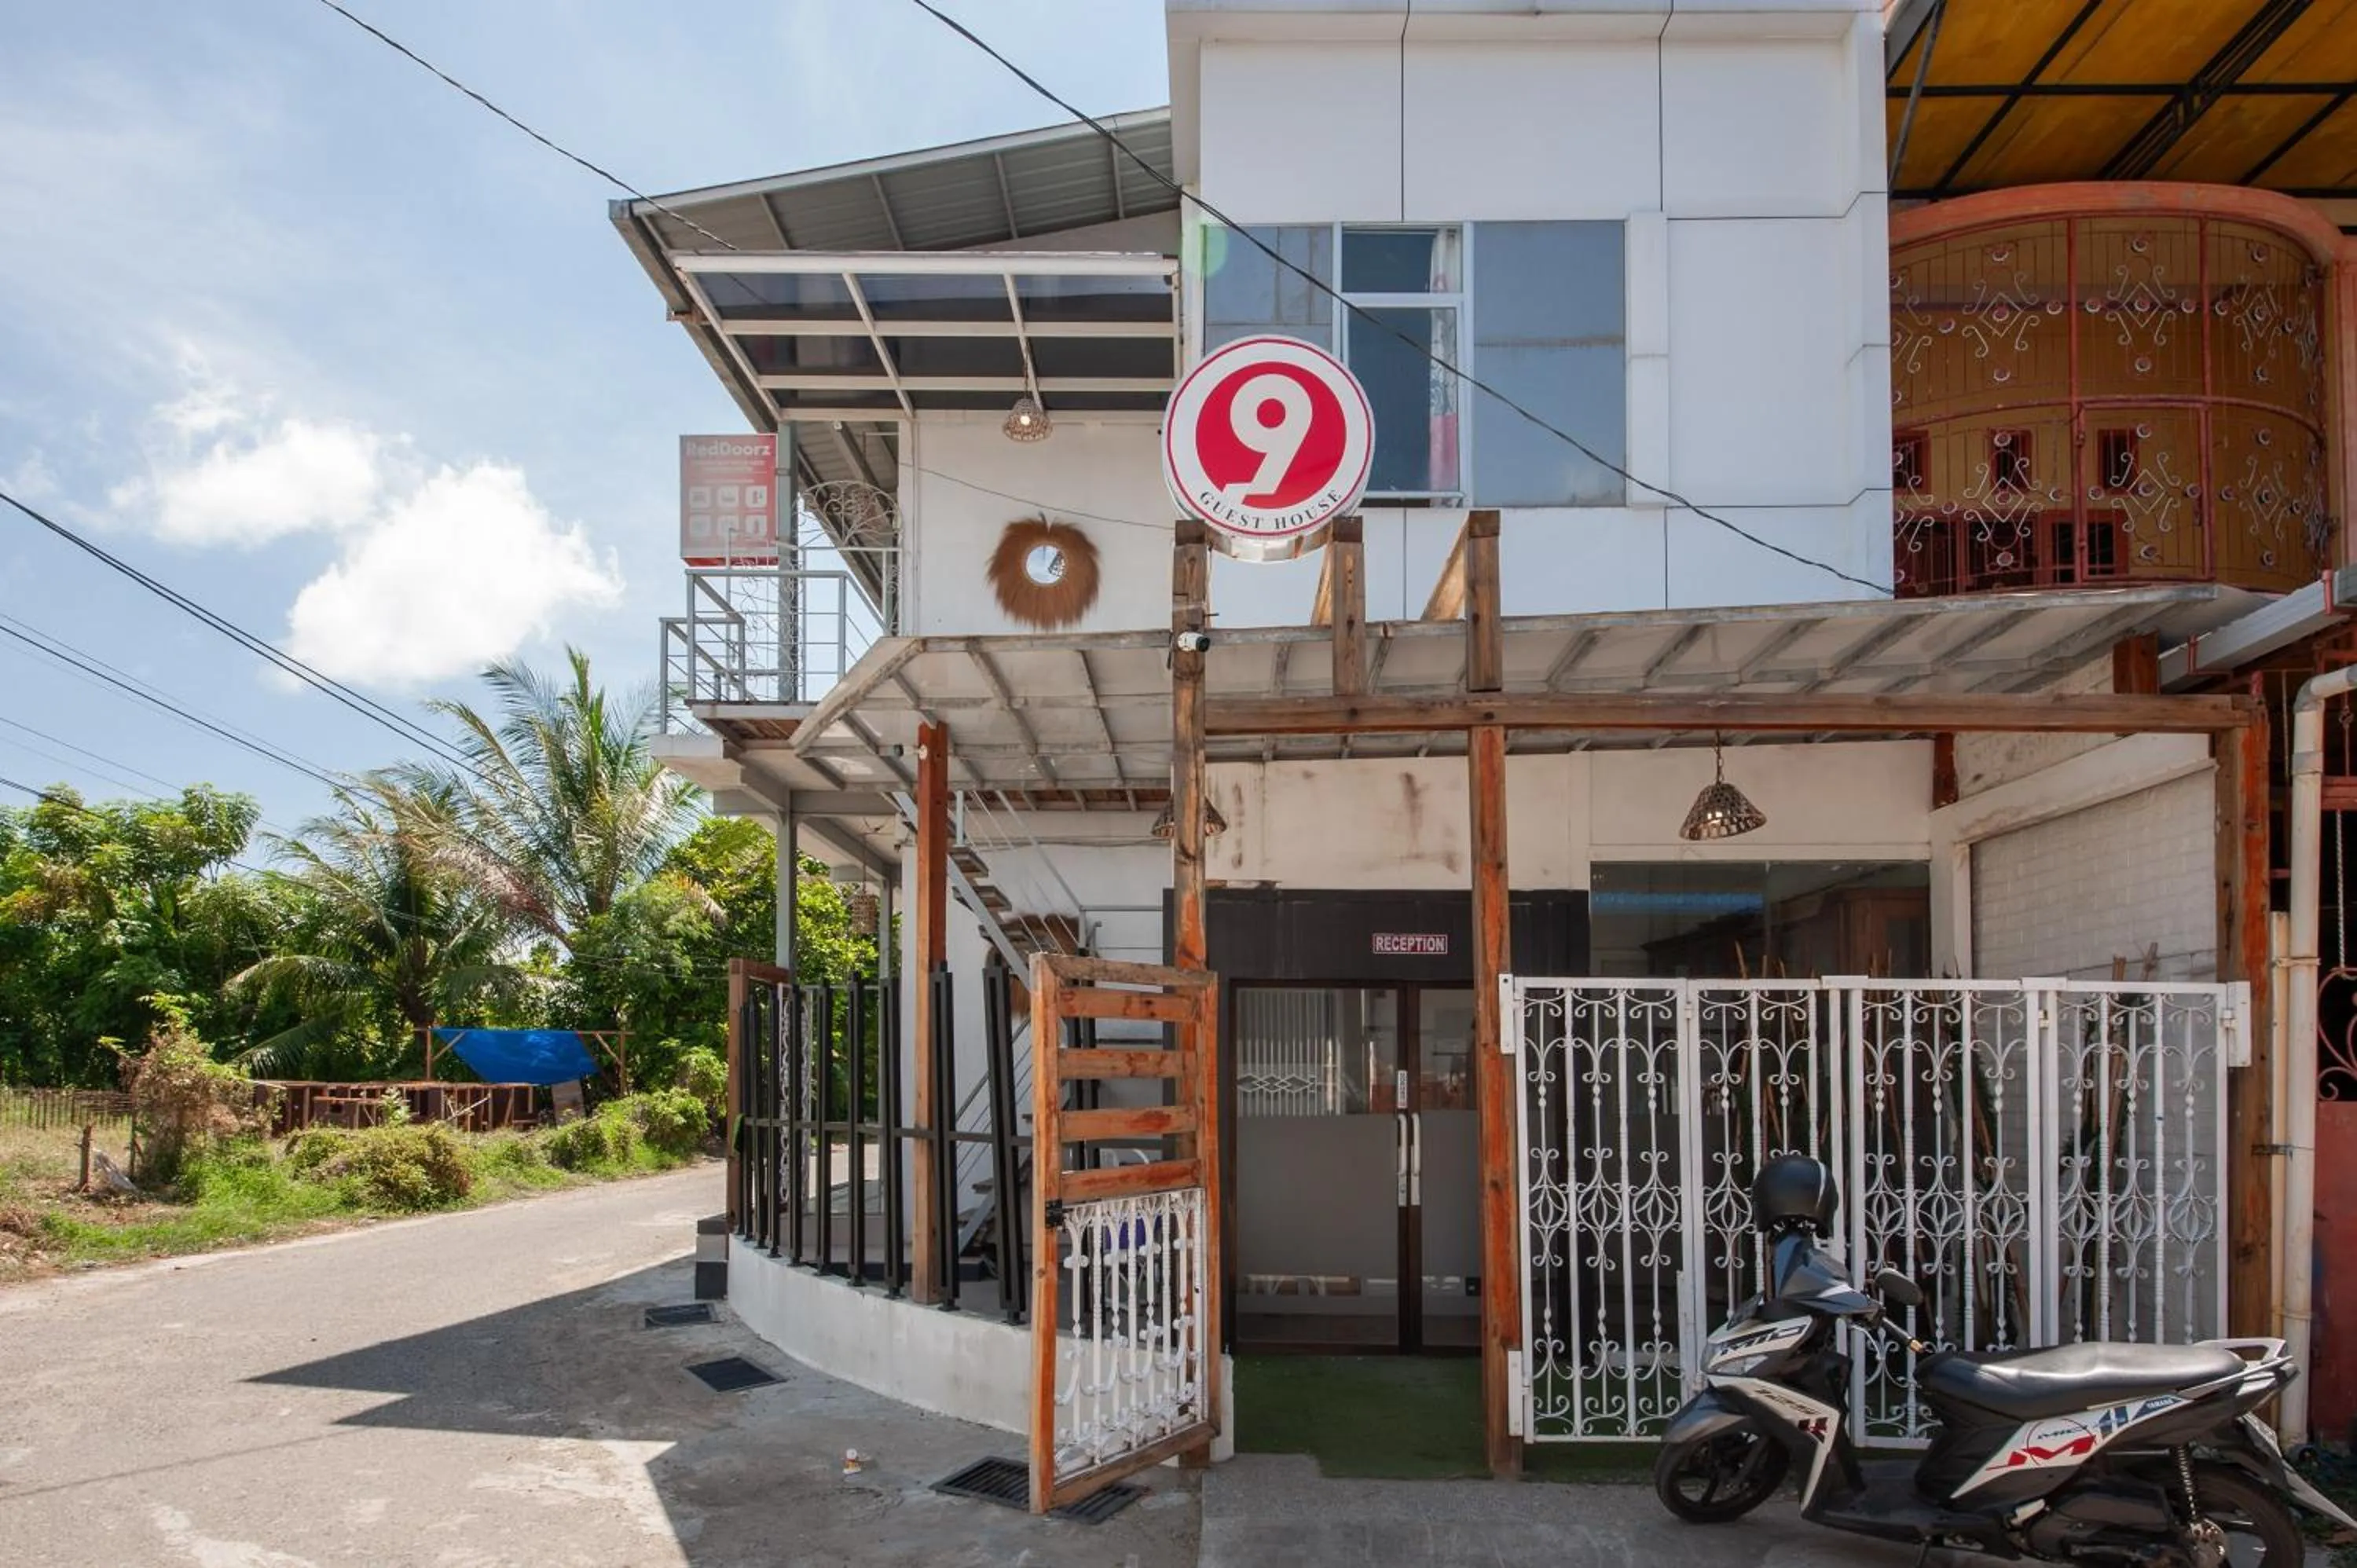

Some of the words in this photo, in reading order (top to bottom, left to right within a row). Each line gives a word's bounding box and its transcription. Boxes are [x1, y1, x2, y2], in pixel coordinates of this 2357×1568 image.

[686, 440, 771, 456] RedDoorz
[1222, 373, 1313, 496] 9
[1200, 490, 1263, 529] GUEST
[1275, 489, 1342, 529] HOUSE
[1376, 936, 1445, 951] RECEPTION
